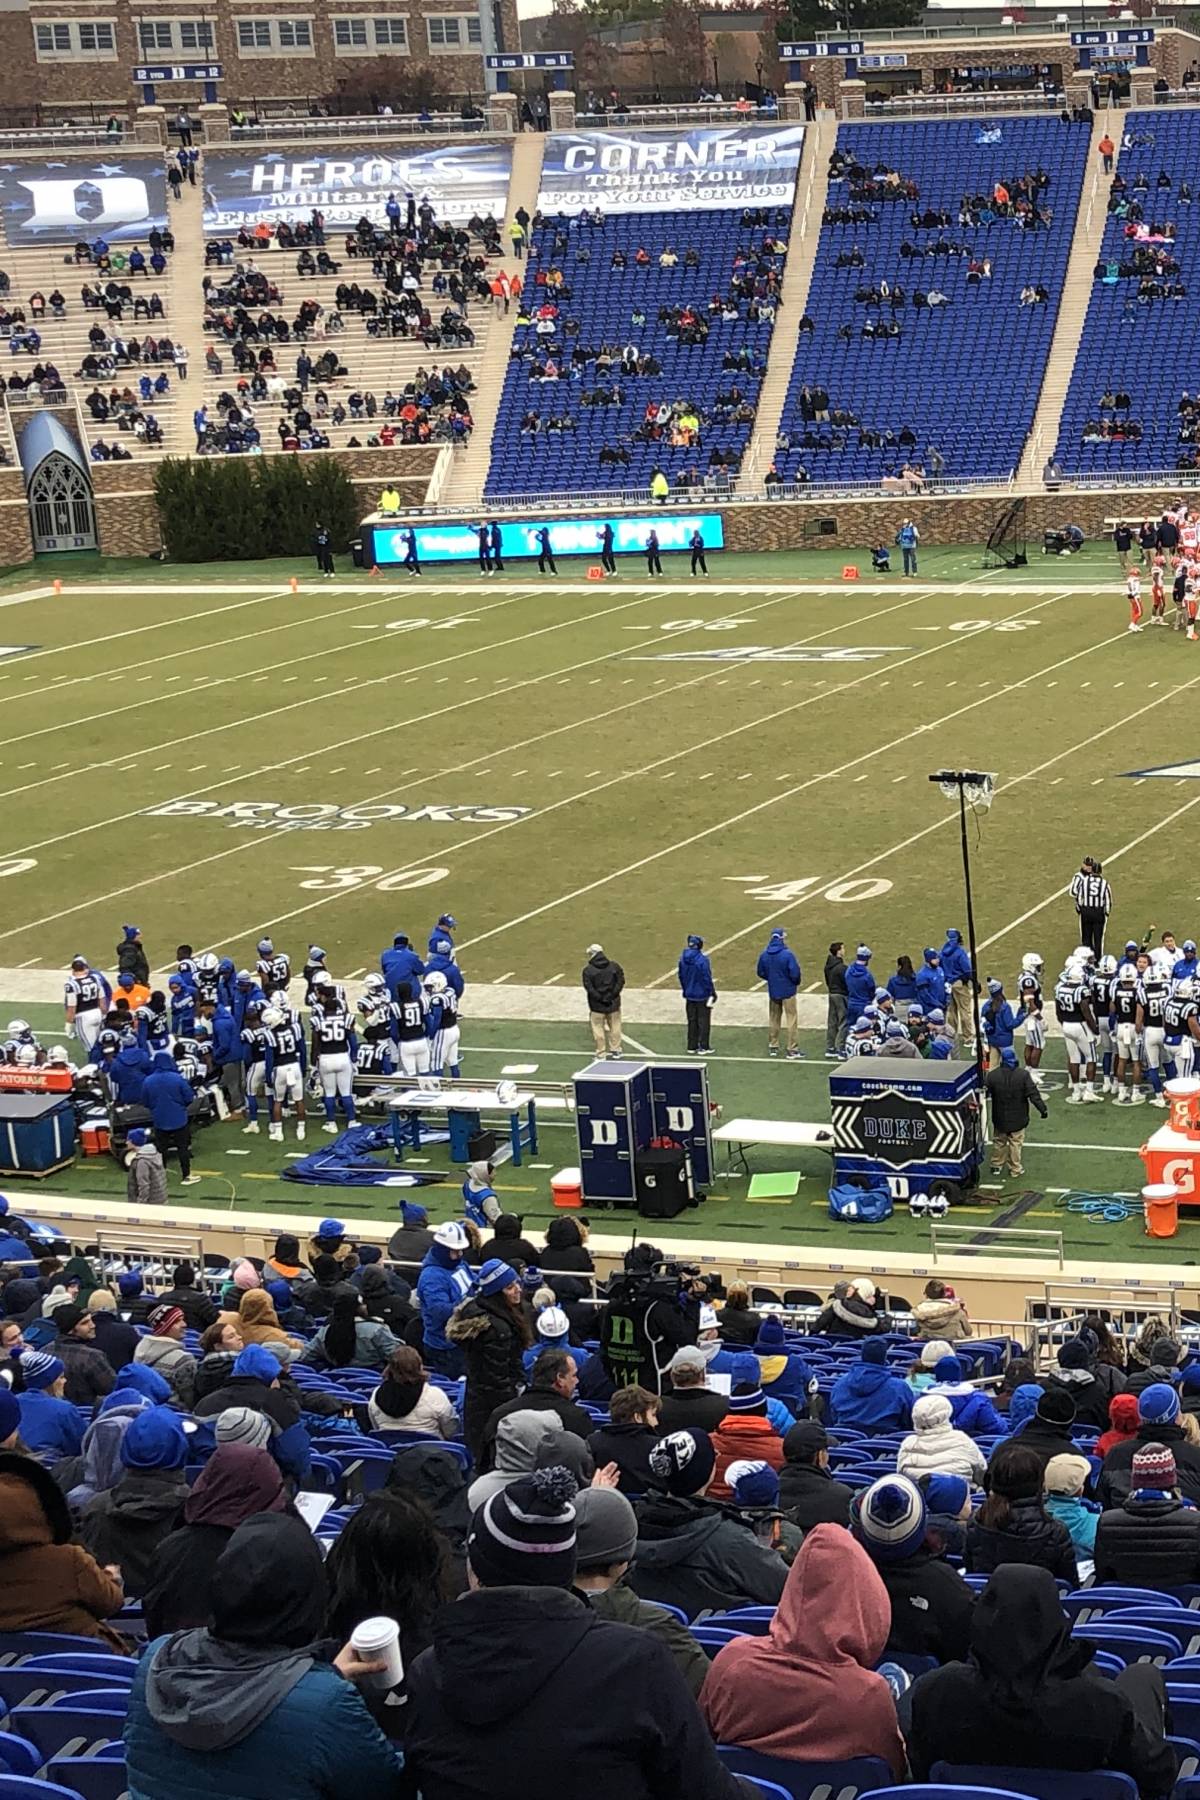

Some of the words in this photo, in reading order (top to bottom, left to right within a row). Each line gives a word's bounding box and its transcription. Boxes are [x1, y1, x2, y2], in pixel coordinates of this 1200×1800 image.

[137, 70, 147, 80] 12
[209, 67, 218, 77] 12
[564, 139, 778, 173] CORNER
[251, 157, 465, 192] HEROES
[585, 171, 680, 187] Thank
[686, 170, 743, 184] You
[544, 192, 600, 205] For
[601, 189, 675, 204] Your
[679, 184, 788, 203] Service
[621, 646, 915, 662] ACC
[138, 801, 535, 824] BROOKS
[227, 819, 374, 832] FIELD
[296, 866, 451, 892] 30
[743, 876, 895, 903] 40
[1089, 882, 1102, 896] S
[272, 963, 287, 981] 53
[82, 984, 98, 1002] 93
[1058, 994, 1074, 1012] 59
[1120, 997, 1130, 1013] 6
[405, 1007, 422, 1027] 91
[321, 1020, 345, 1042] 56
[278, 1035, 296, 1055] 13
[357, 1049, 374, 1068] 97
[861, 1082, 923, 1092] coachcomm.com
[1175, 1101, 1189, 1116] G
[666, 1106, 694, 1132] D
[863, 1117, 927, 1140] DUKE
[589, 1119, 618, 1145] D
[644, 1175, 657, 1188] G
[1162, 1158, 1196, 1195] G
